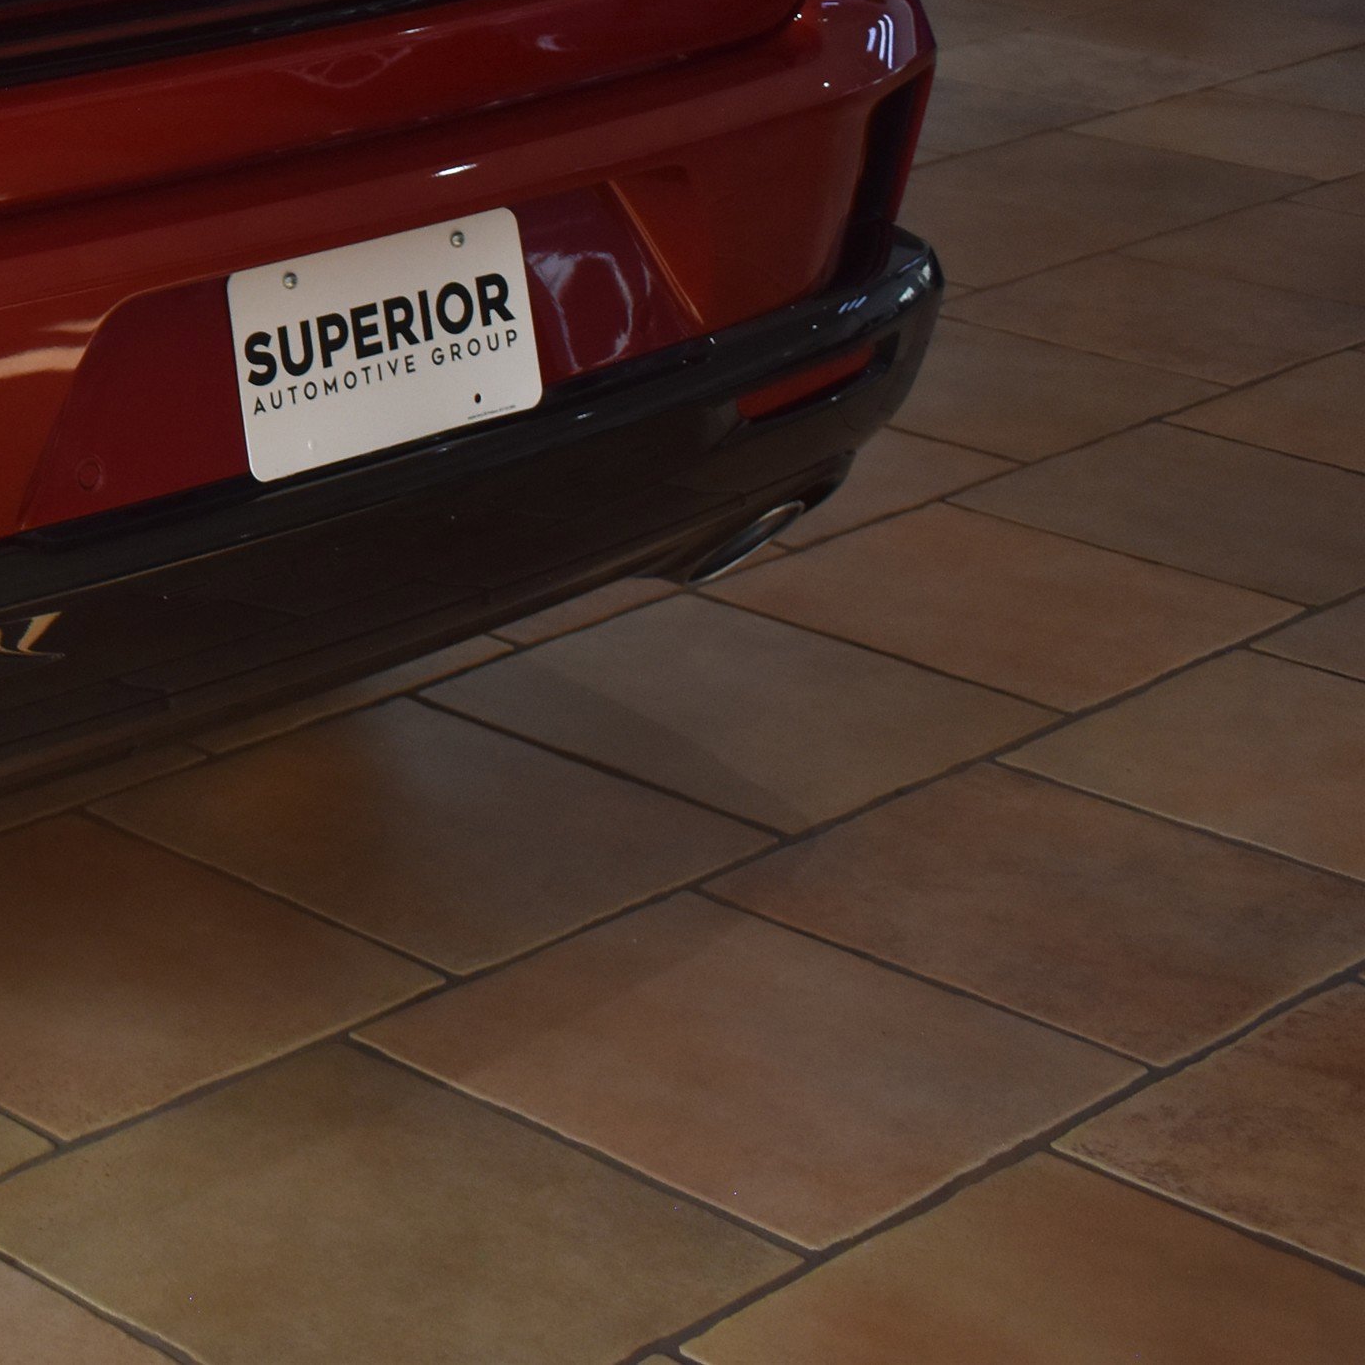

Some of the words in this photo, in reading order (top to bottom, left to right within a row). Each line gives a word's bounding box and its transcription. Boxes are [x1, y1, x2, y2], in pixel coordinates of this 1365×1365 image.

[243, 272, 516, 386] SUPERIOR
[253, 354, 416, 415] AUTOMOTIVE
[431, 329, 517, 366] GROUP
